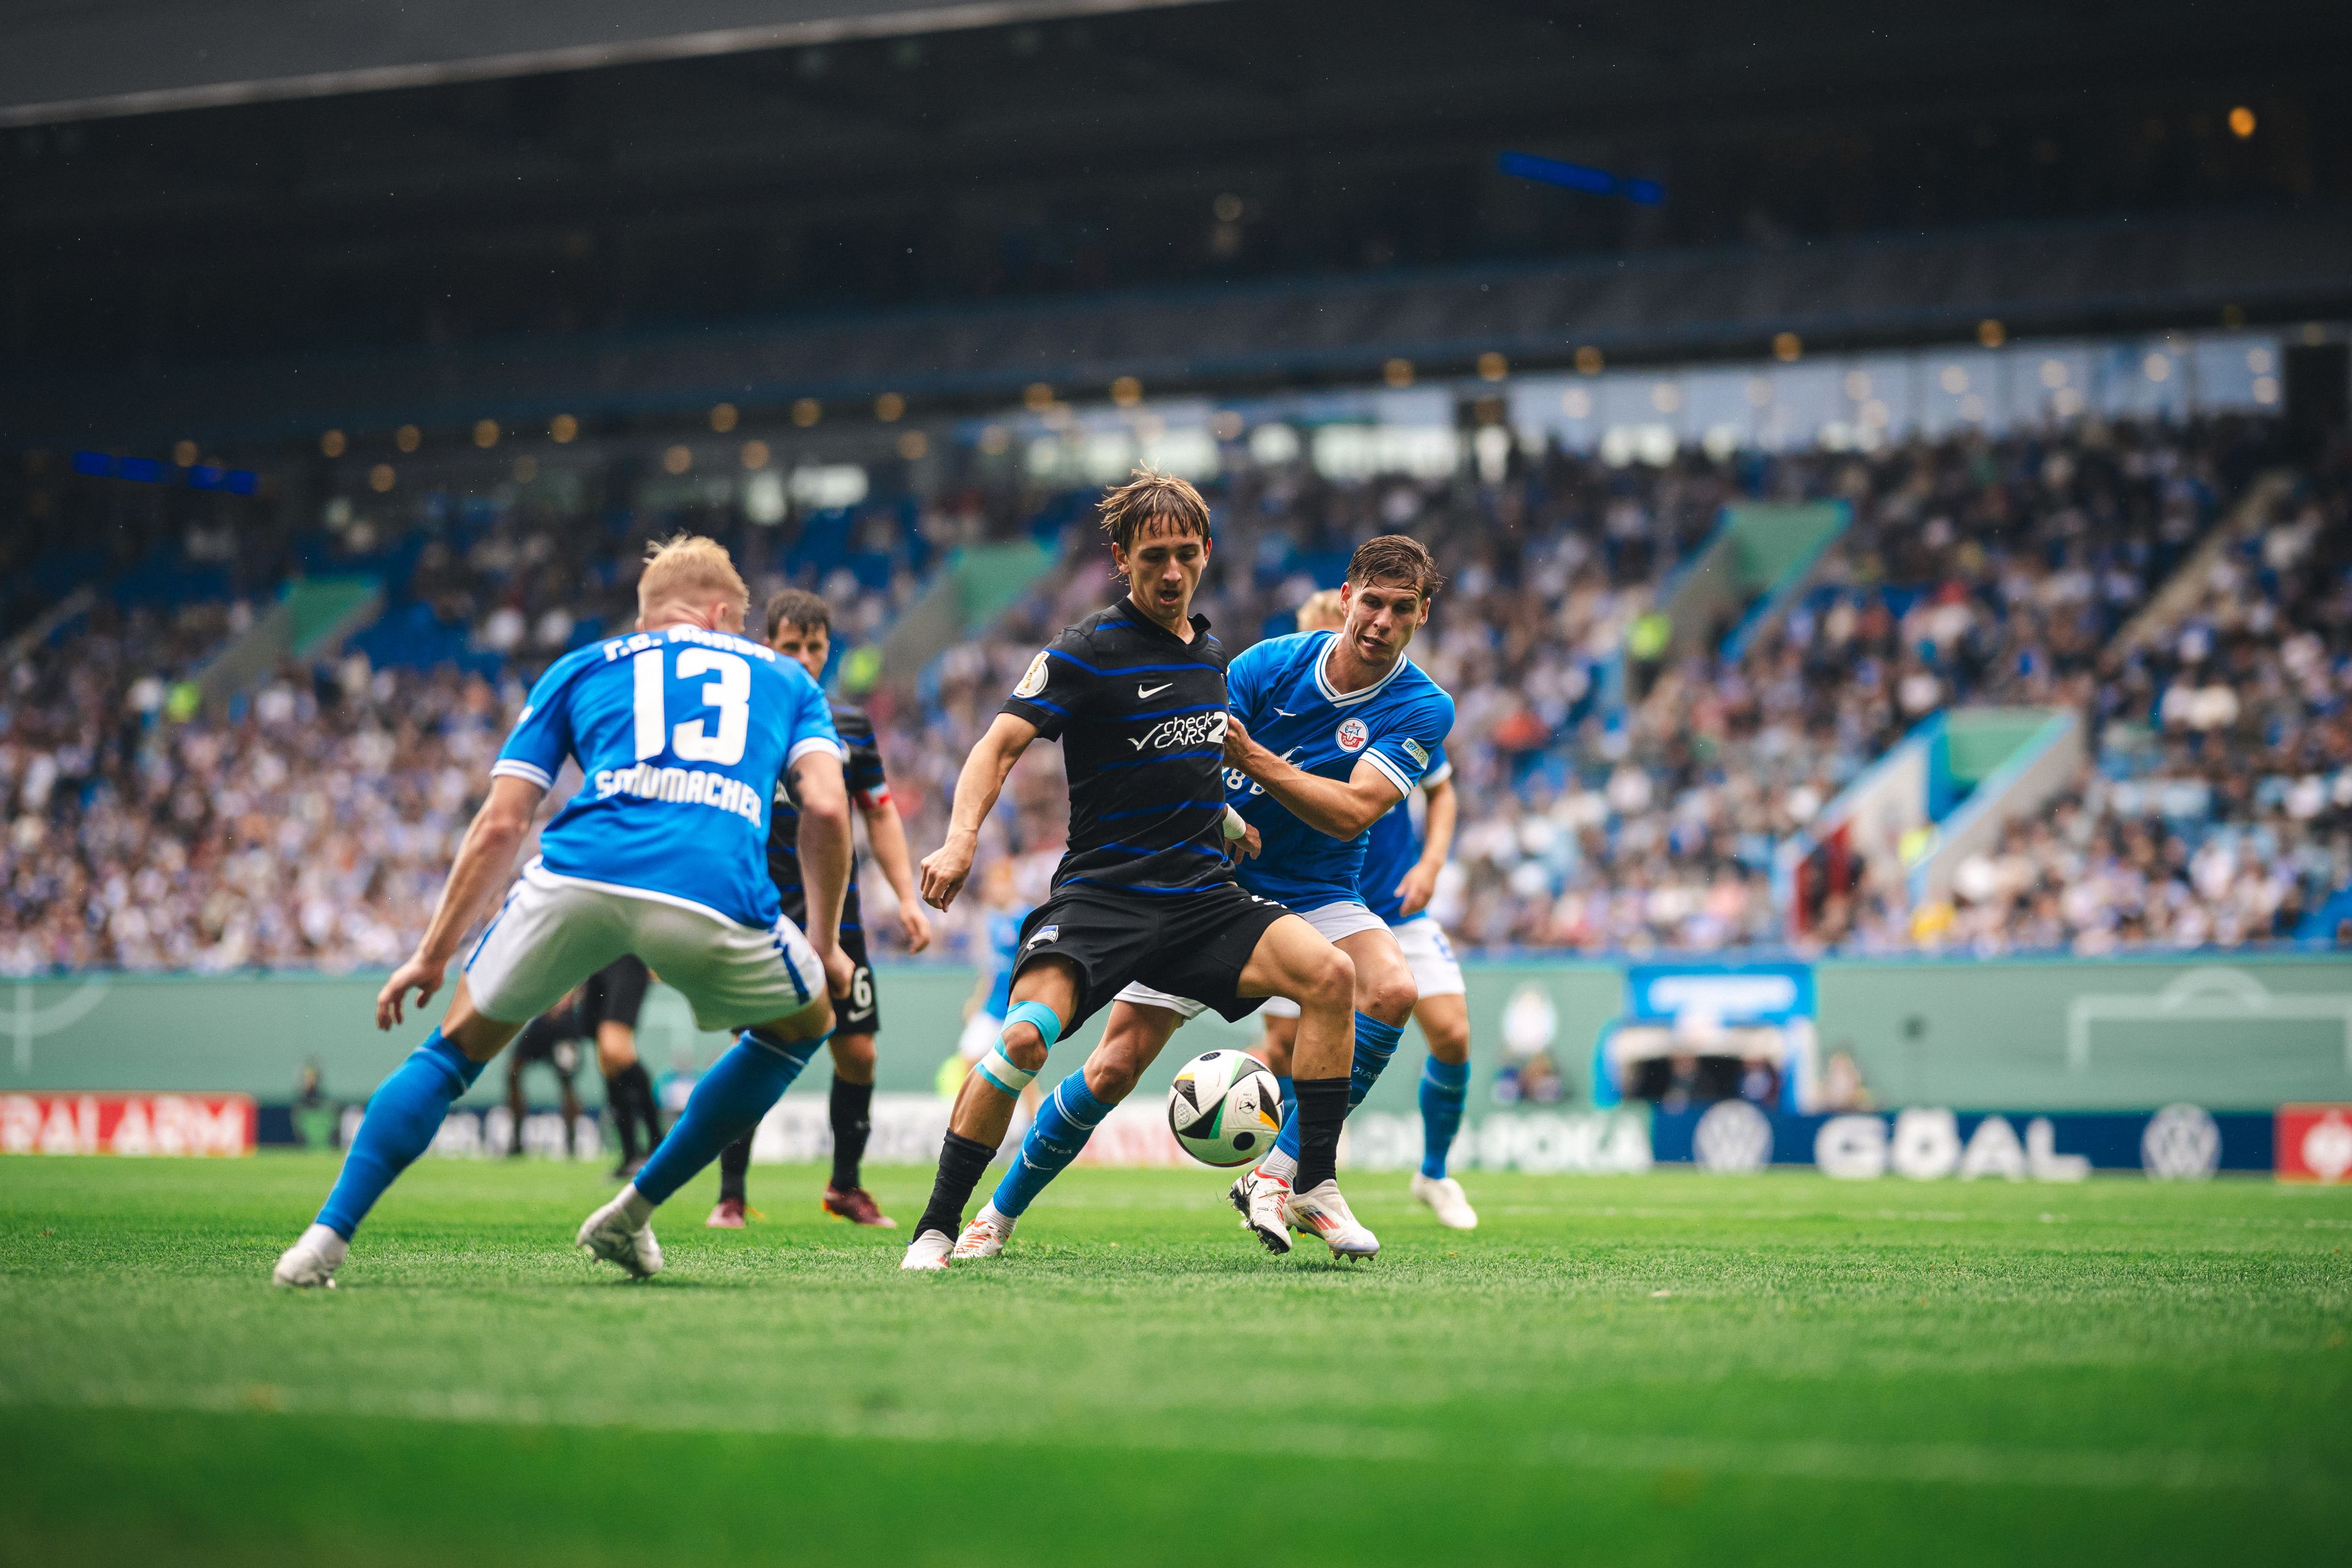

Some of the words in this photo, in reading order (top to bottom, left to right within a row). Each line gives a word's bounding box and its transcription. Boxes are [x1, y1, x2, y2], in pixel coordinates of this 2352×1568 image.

[634, 648, 751, 766] 13
[1163, 711, 1214, 734] check
[1154, 727, 1207, 749] CARS
[1206, 711, 1228, 744] 2
[853, 966, 872, 1008] 6
